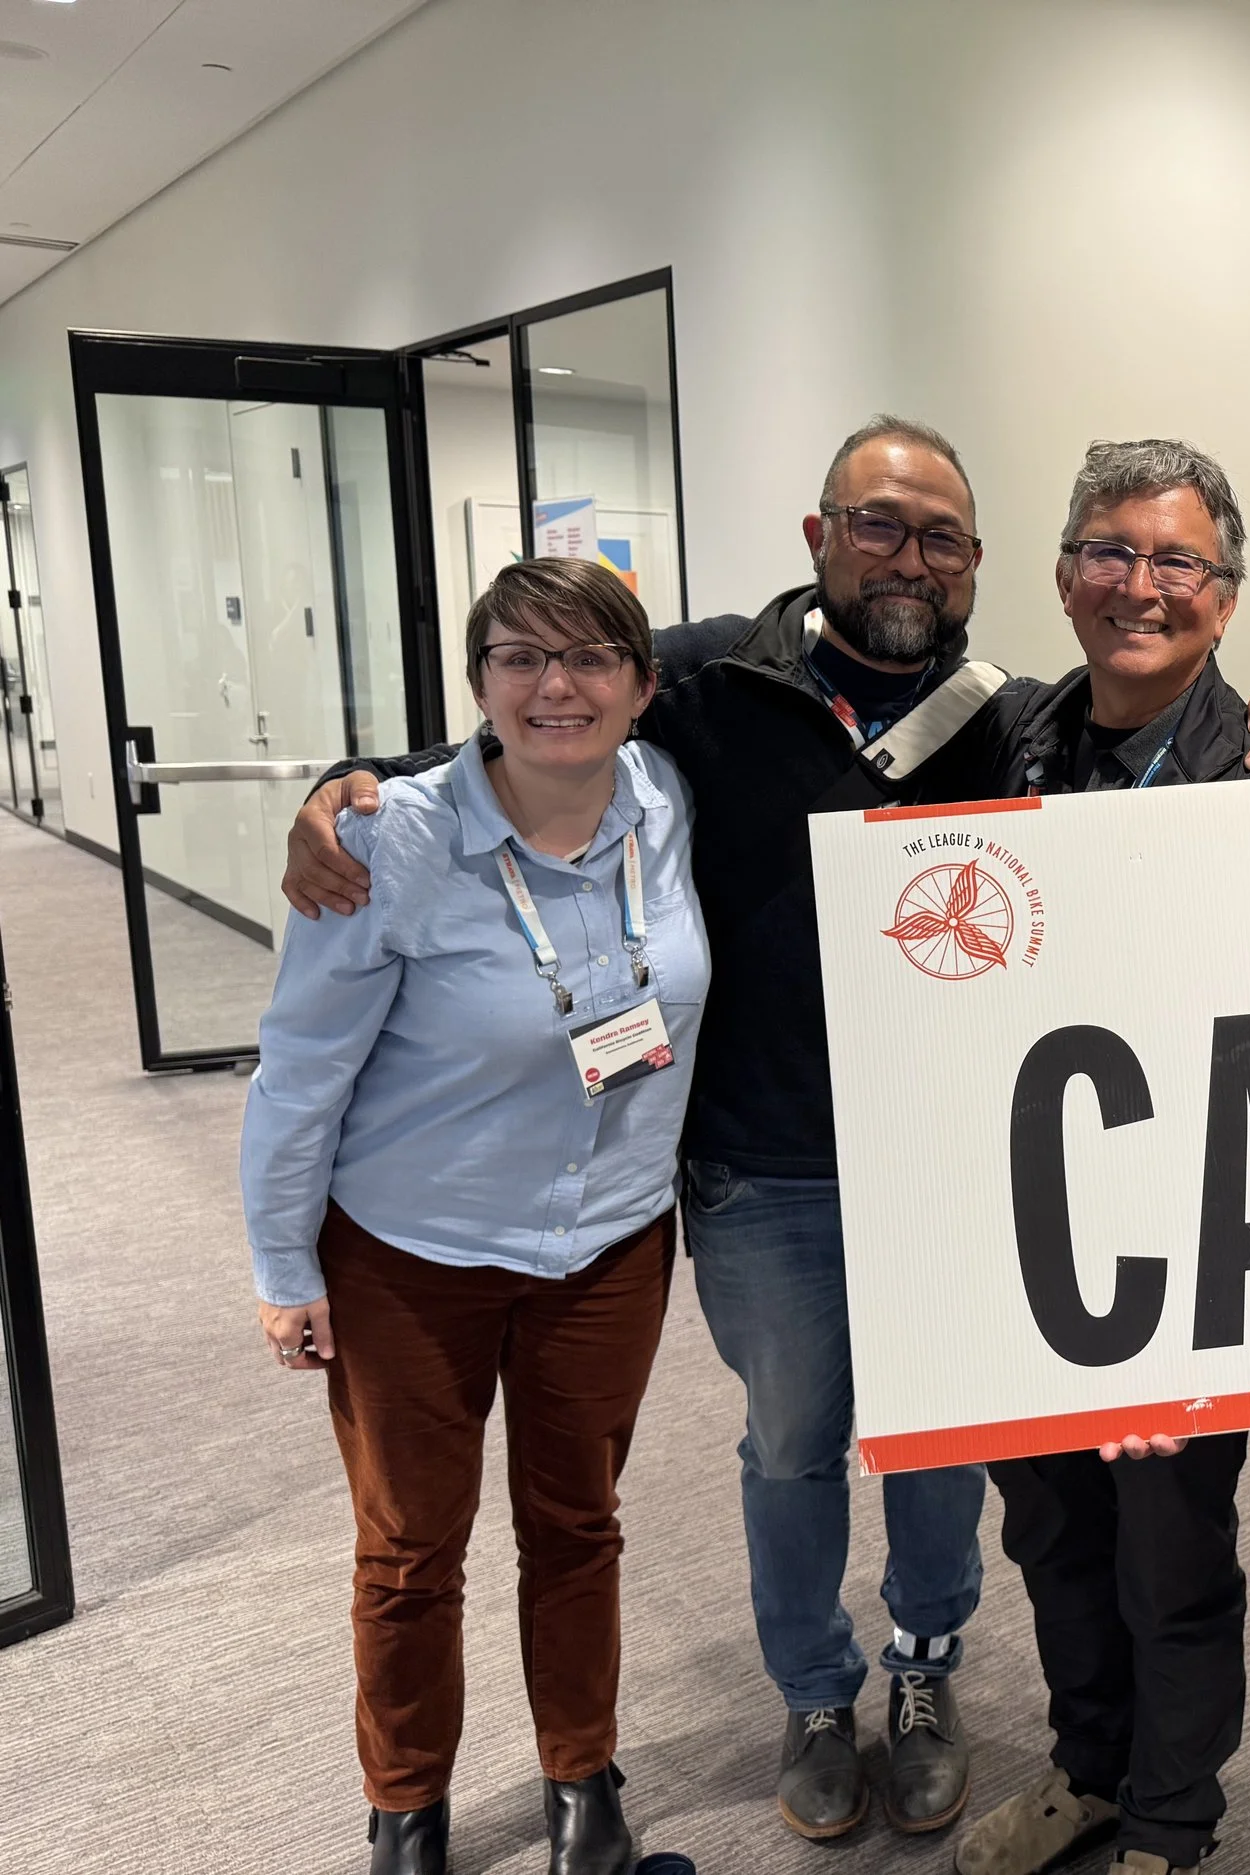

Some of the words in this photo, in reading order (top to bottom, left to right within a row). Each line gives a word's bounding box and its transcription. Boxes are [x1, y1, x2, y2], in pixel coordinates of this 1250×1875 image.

[903, 839, 926, 858] THE
[928, 833, 971, 848] LEAGUE
[985, 841, 1033, 887] NATIONAL
[1026, 888, 1044, 916] BIKE
[1021, 921, 1045, 968] SUMMIT
[590, 1031, 618, 1045] Kendra
[620, 1019, 649, 1035] Ramsey
